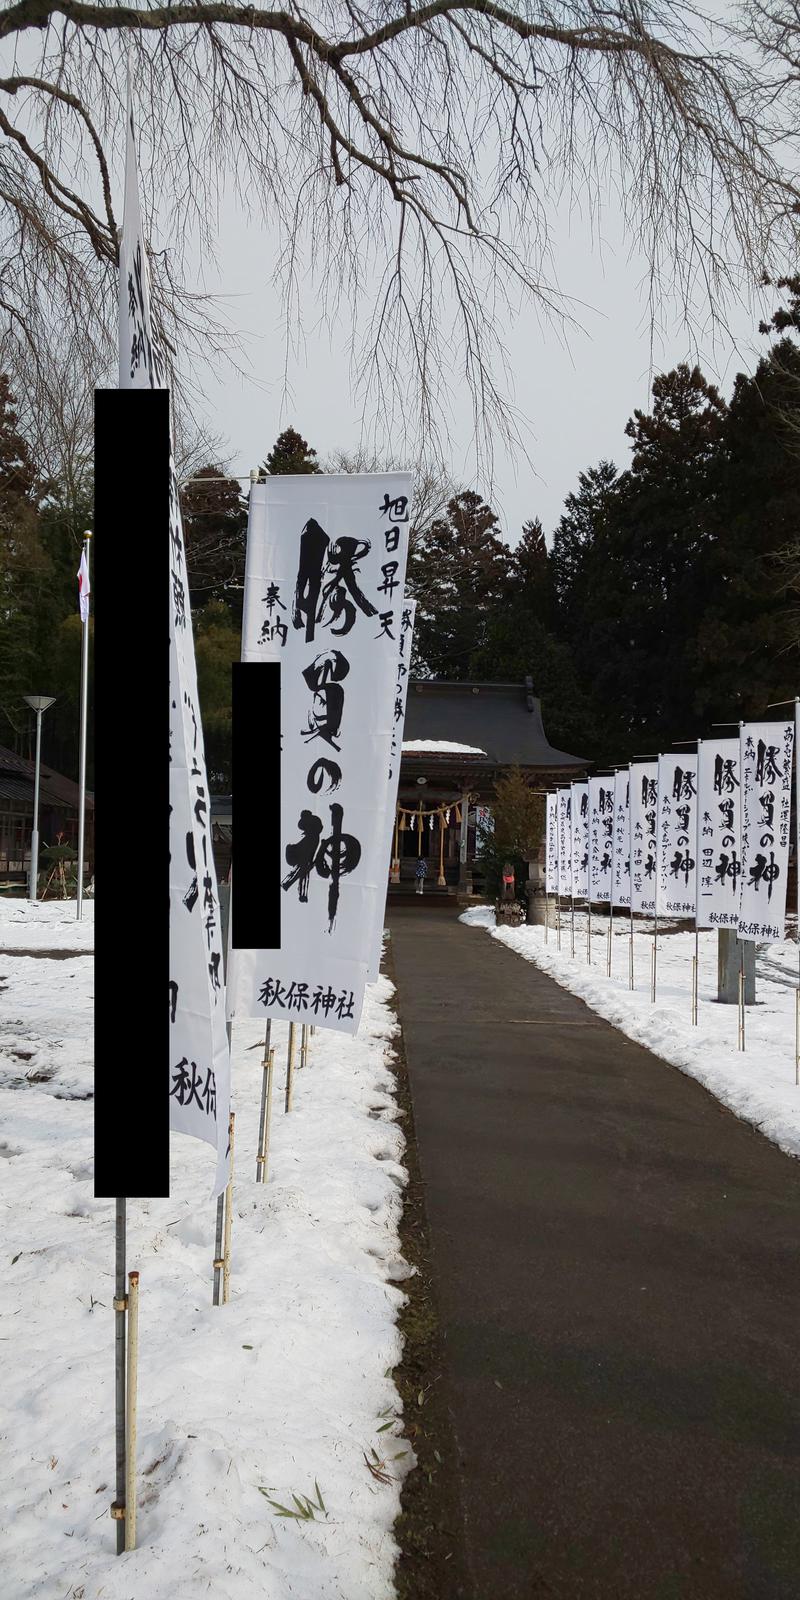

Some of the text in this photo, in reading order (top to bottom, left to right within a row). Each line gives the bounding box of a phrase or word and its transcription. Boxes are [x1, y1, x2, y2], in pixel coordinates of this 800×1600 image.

[375, 493, 409, 640] 旭日昇天
[256, 581, 288, 648] 奉納
[738, 920, 780, 939] 秋保神社
[257, 977, 357, 1021] 秋保神社
